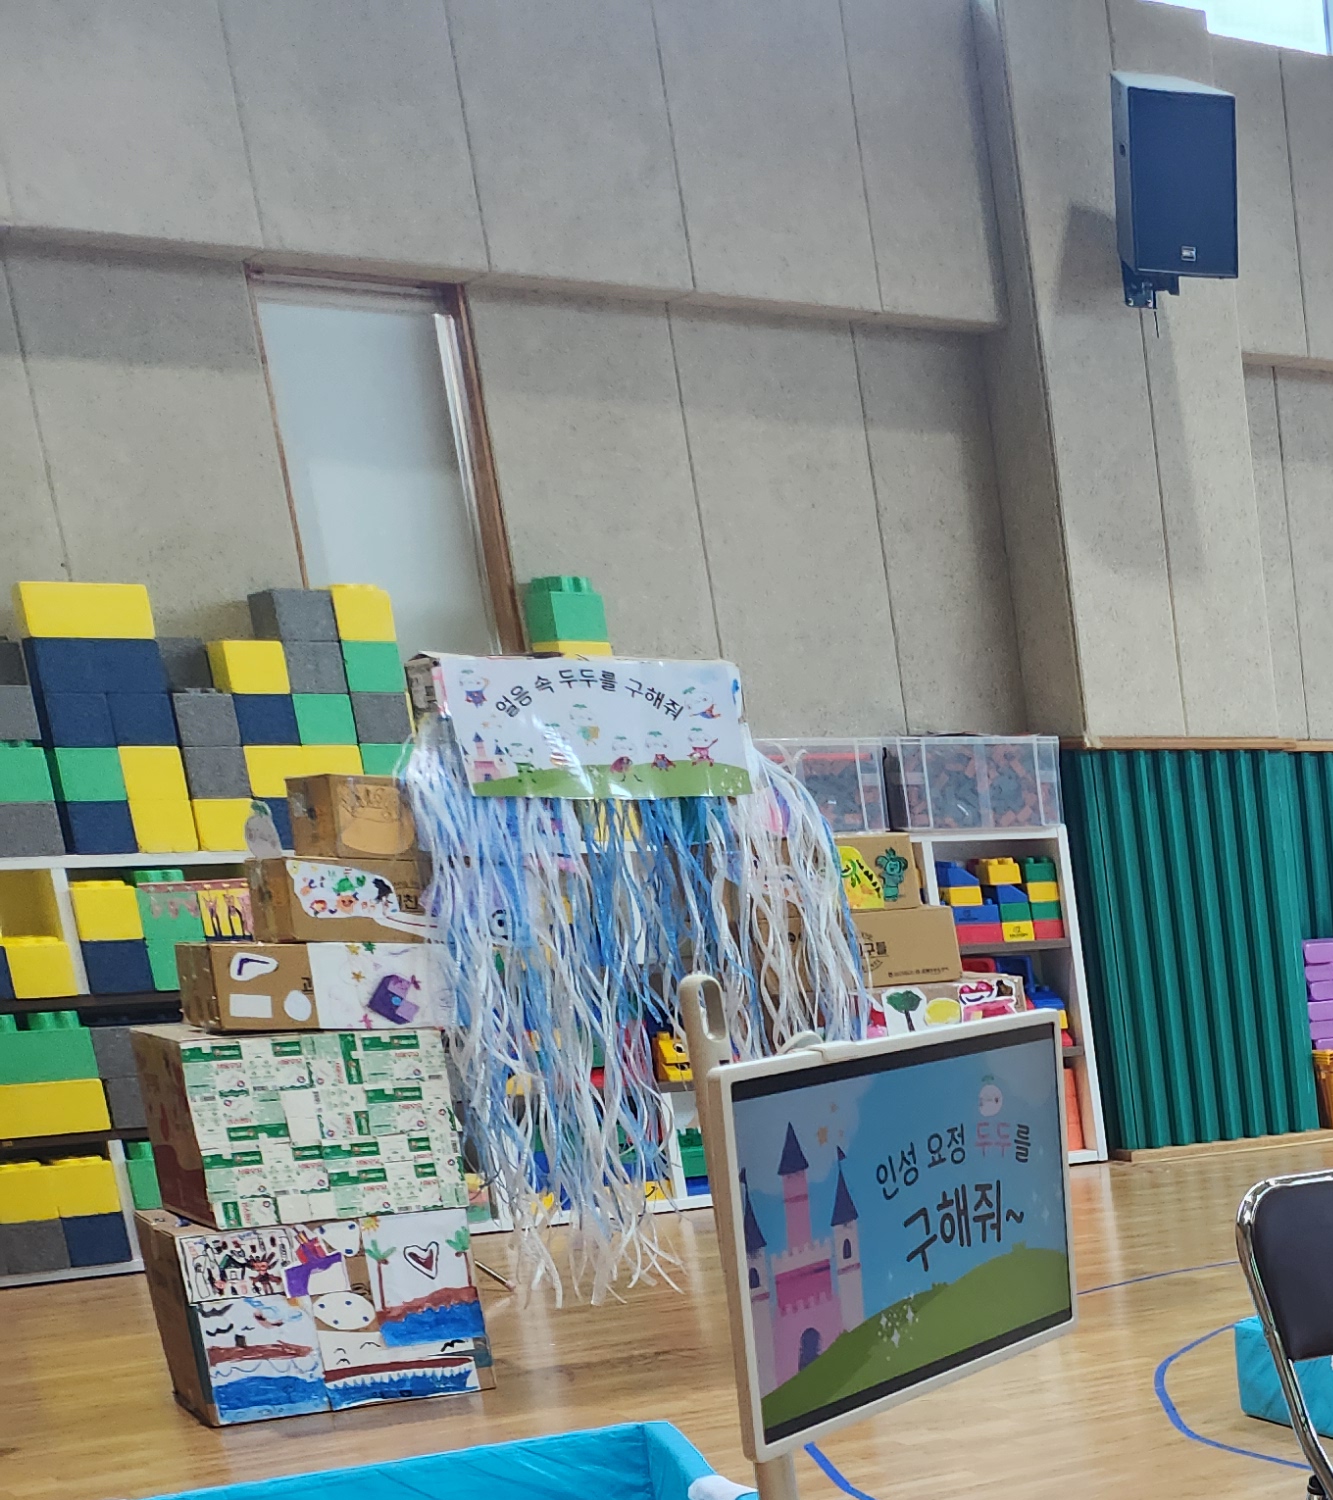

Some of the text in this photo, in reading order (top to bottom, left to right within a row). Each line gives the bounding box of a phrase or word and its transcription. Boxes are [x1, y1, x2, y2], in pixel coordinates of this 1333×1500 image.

[495, 669, 684, 721] 얼음 속 두두를 구해줘
[876, 1121, 1032, 1200] 인성 요정 두두를
[903, 1179, 1024, 1272] 구해줘~
